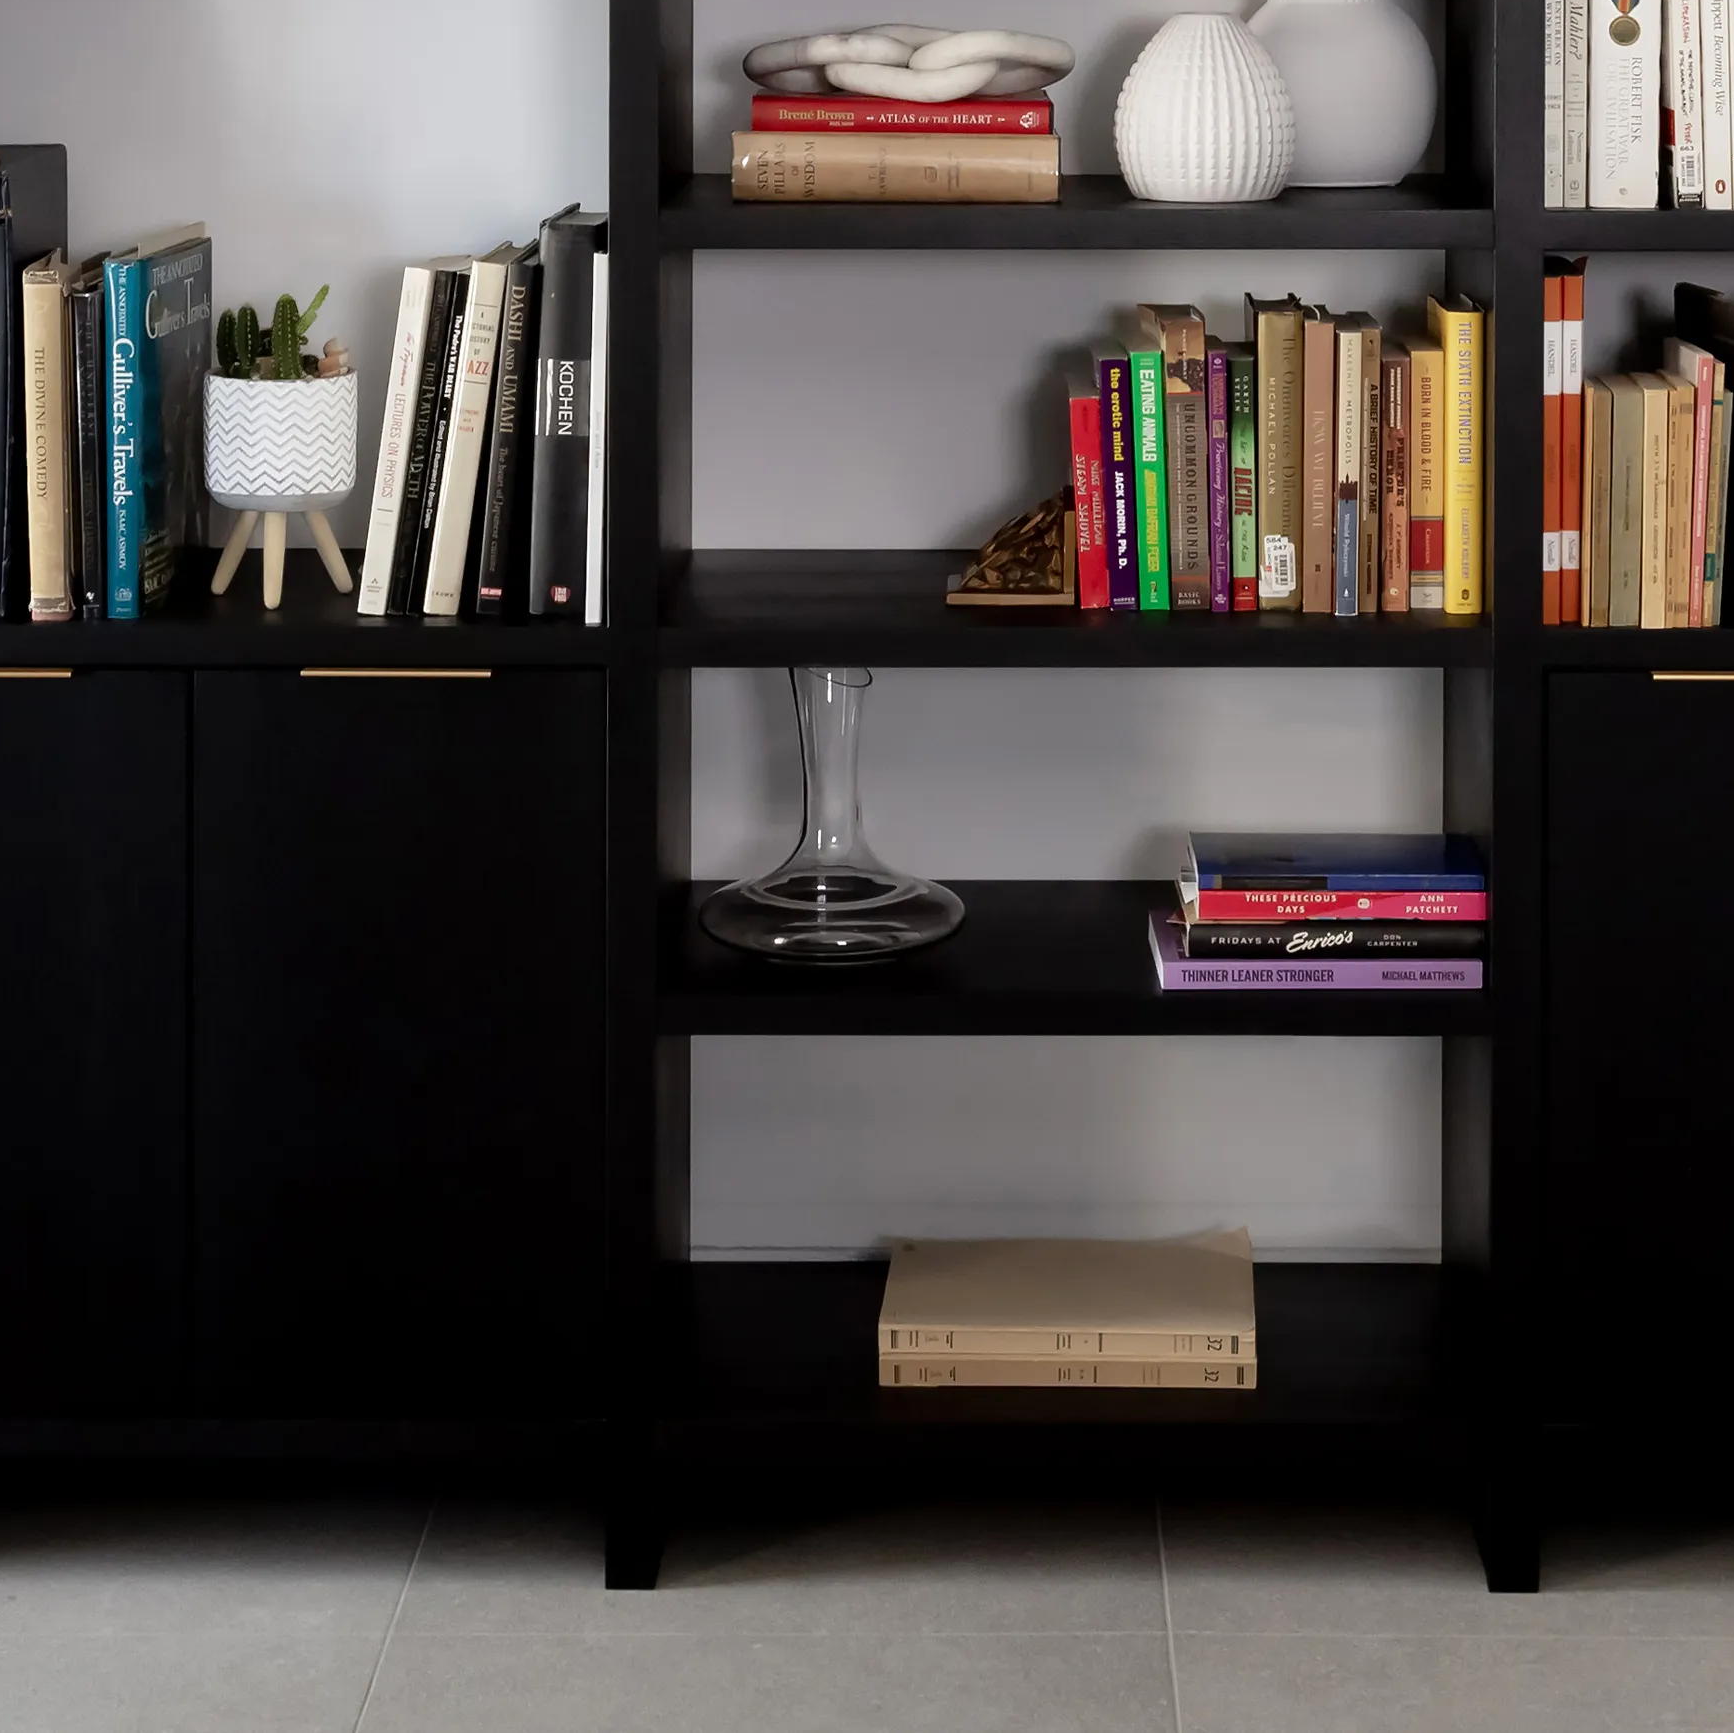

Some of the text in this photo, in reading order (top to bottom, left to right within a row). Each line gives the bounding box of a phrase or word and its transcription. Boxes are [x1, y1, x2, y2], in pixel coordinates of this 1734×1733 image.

[879, 114, 915, 124] ATLAS
[953, 114, 992, 124] HEART
[499, 285, 526, 433] DASHI AND UMAMI
[558, 361, 573, 435] KOCHEN
[1140, 369, 1155, 414] EATING
[113, 338, 134, 505] Gulliver's Travels
[1110, 368, 1126, 537] the erotic mind JACK MORIN,
[1245, 894, 1337, 902] THESE PRECIOUS
[1277, 905, 1305, 913] DAYS
[1211, 937, 1262, 945] FRIDAYS
[1182, 970, 1465, 982] THINNER LEANER STRONGER MICHAEL MATTHEWS
